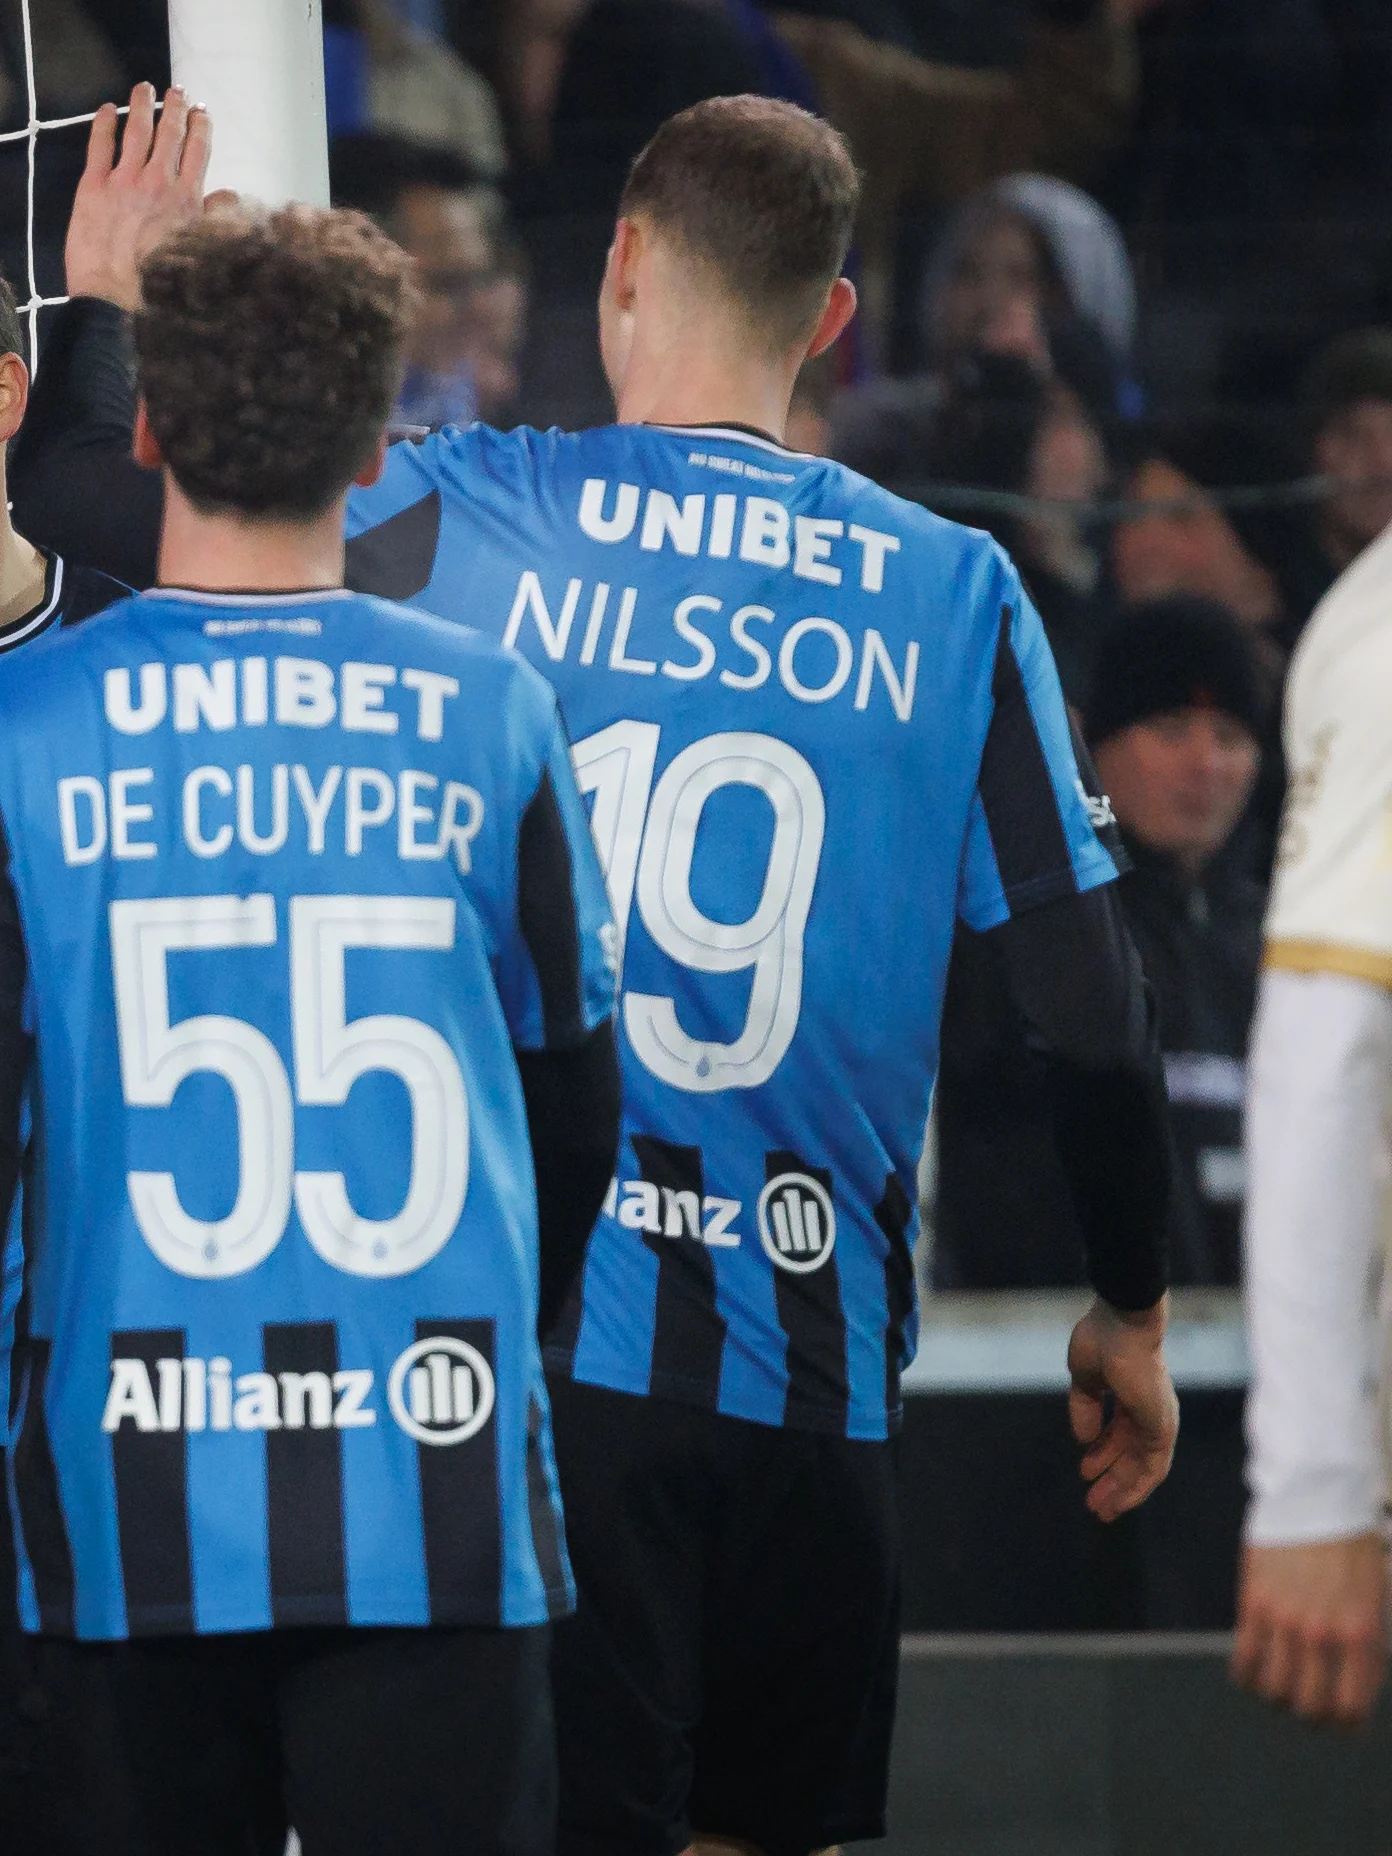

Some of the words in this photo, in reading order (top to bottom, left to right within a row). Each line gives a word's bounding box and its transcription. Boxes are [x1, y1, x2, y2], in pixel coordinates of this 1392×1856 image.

[578, 478, 901, 594] UNIBET
[104, 655, 460, 742] UNIBET
[503, 570, 920, 722] NILSSON
[57, 767, 158, 866] DE
[182, 764, 485, 874] CUYPER
[571, 719, 825, 1092] 19
[111, 893, 469, 1278] 55
[101, 1357, 376, 1432] Allianz
